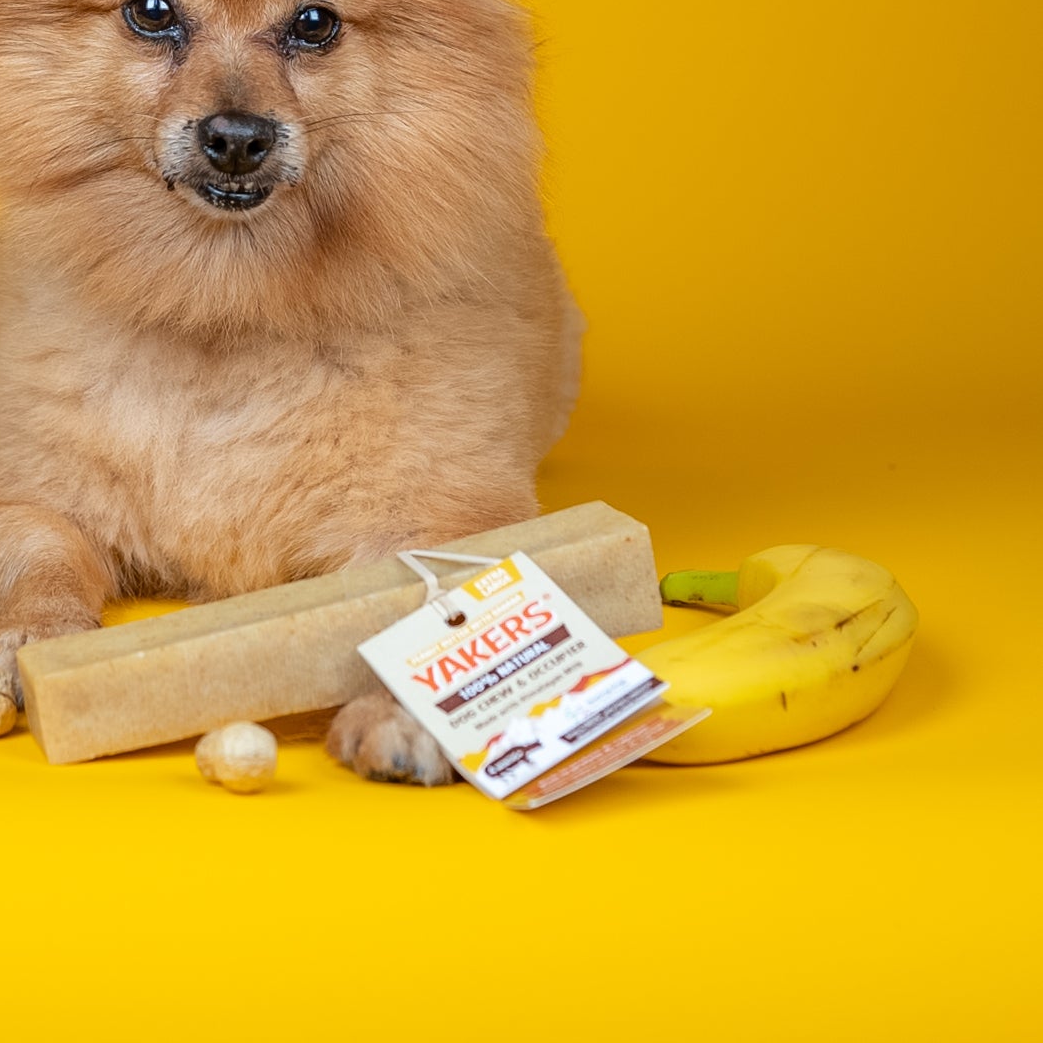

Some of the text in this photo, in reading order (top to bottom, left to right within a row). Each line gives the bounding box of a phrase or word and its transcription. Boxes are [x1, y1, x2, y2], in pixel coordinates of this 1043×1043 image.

[410, 598, 556, 697] YAKERS
[448, 638, 587, 729] DOG CHEW & OCCUPIER
[456, 637, 553, 702] 100% NATURAL
